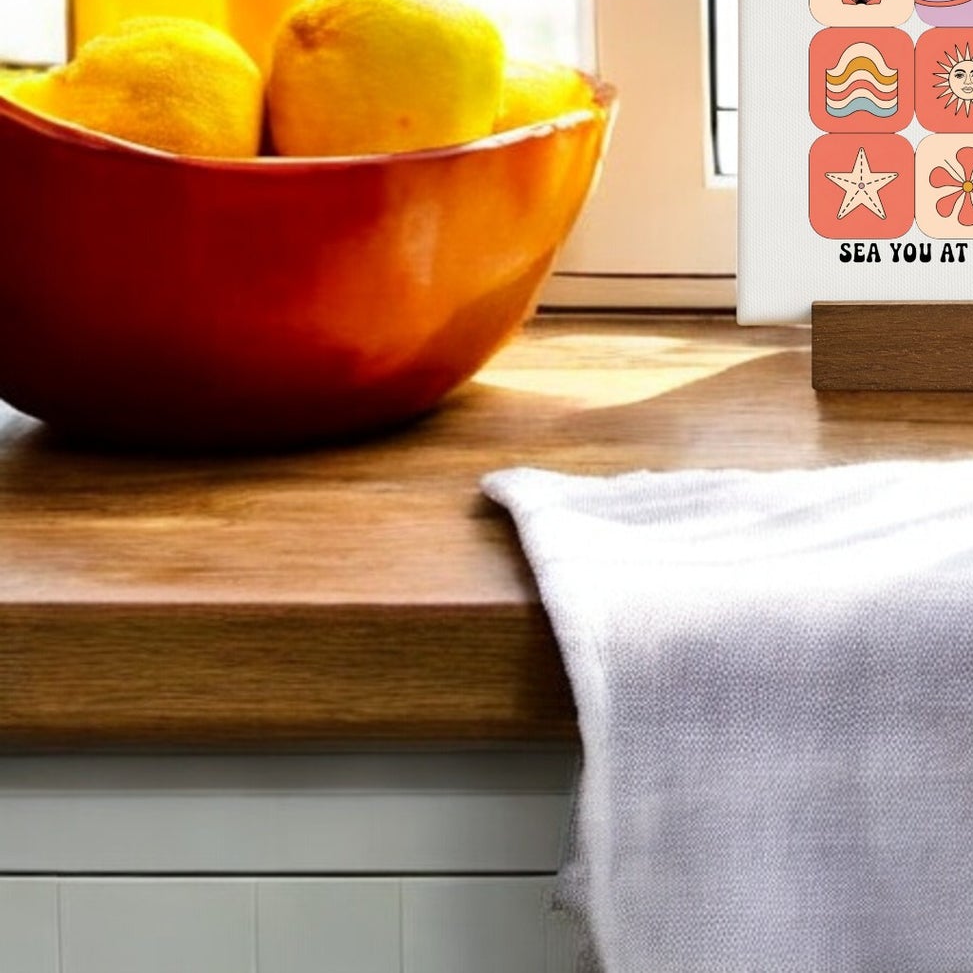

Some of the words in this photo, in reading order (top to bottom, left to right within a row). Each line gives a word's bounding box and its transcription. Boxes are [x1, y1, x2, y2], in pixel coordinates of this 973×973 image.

[839, 242, 881, 263] SEA
[889, 242, 932, 263] YOU
[940, 242, 968, 263] AT
